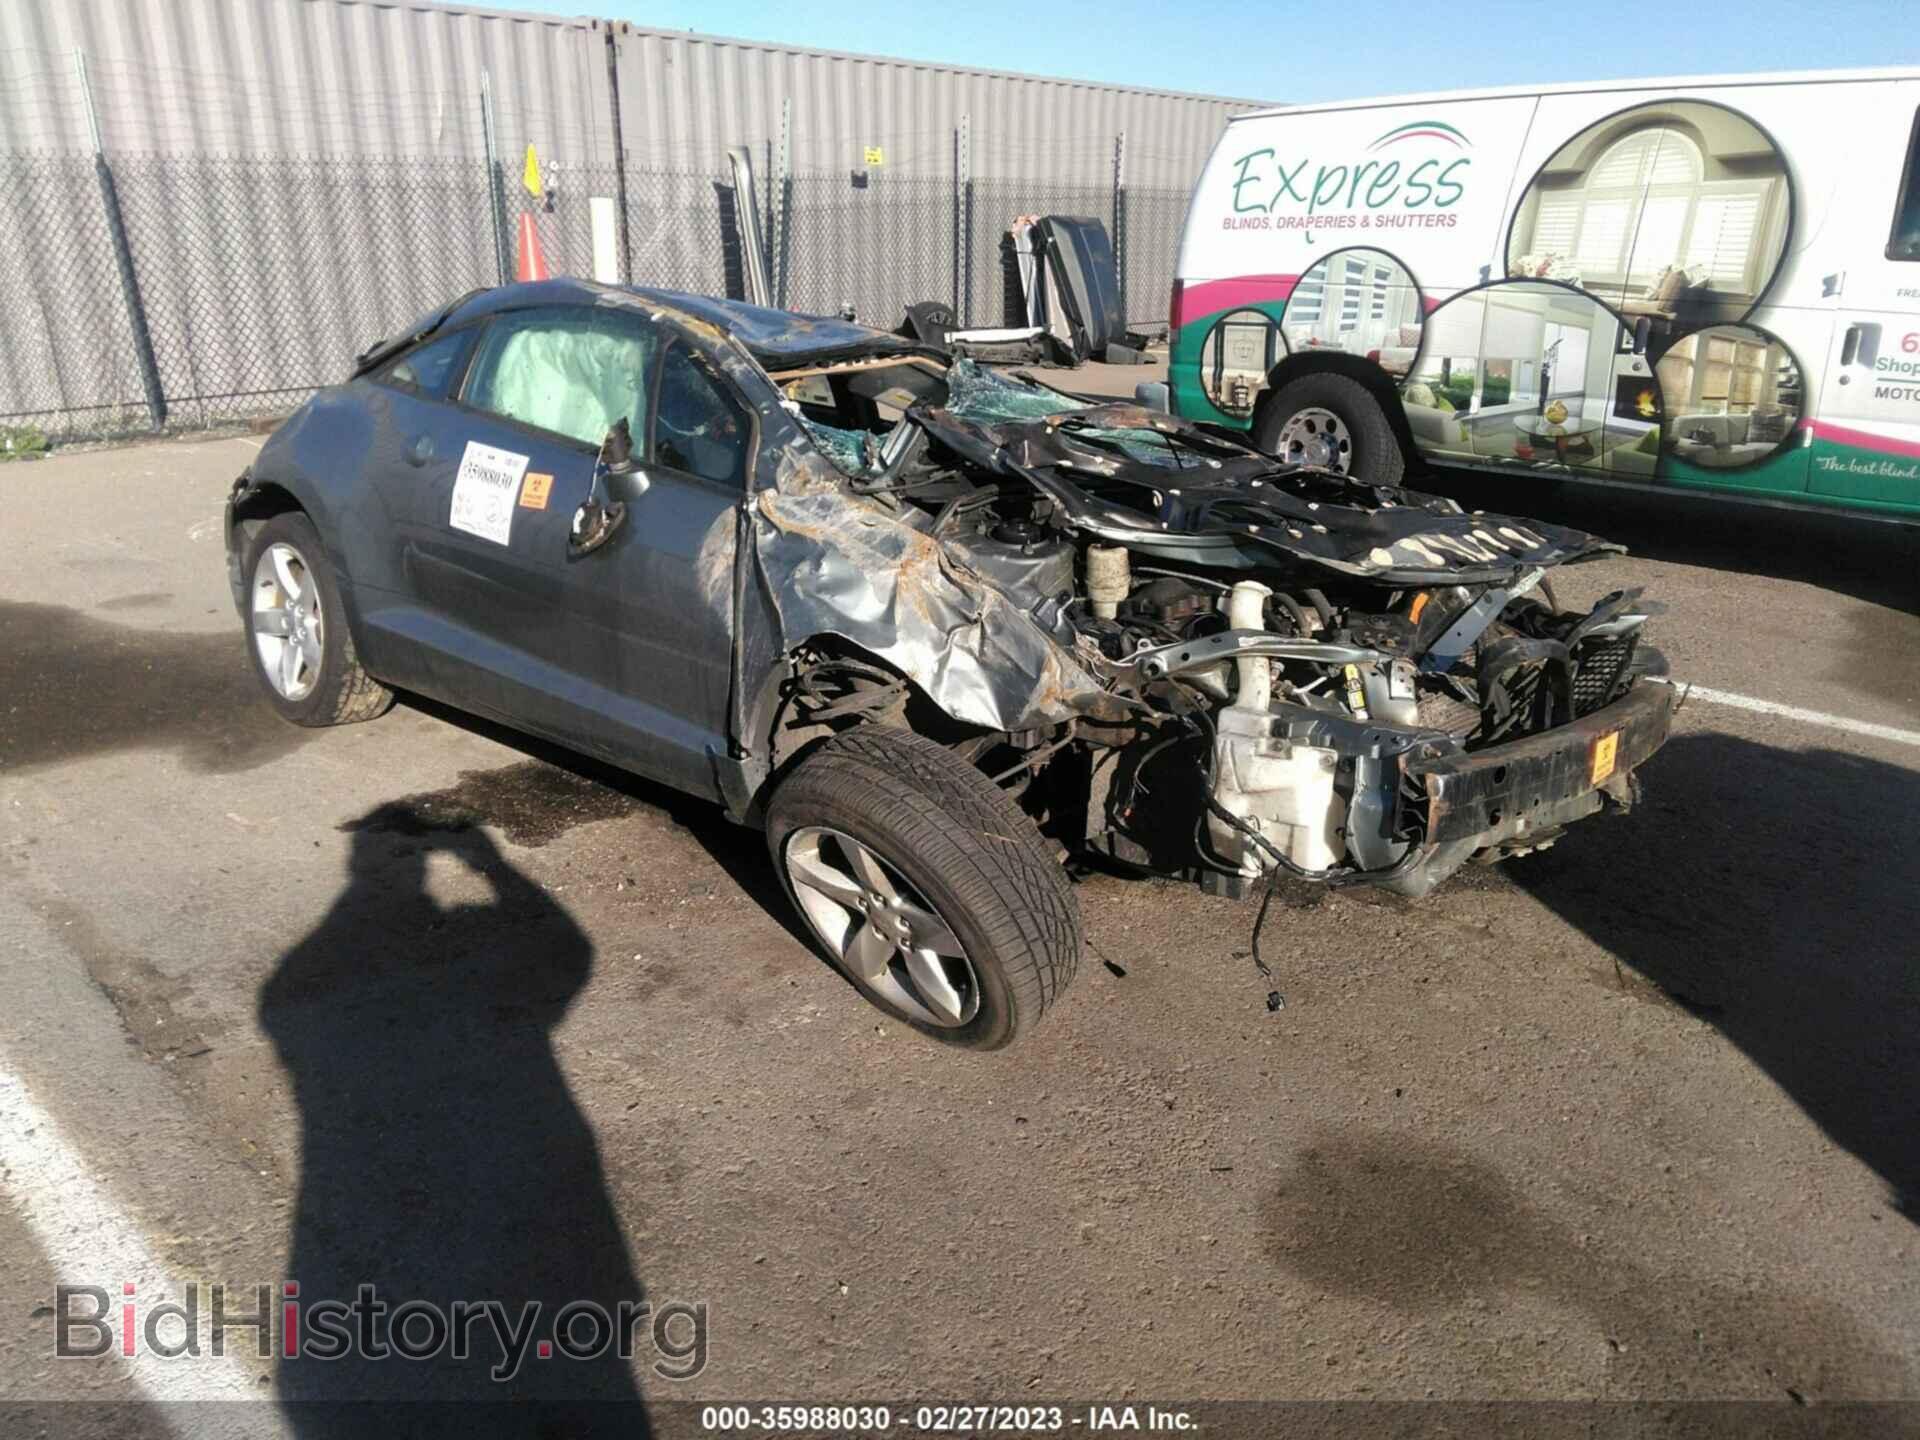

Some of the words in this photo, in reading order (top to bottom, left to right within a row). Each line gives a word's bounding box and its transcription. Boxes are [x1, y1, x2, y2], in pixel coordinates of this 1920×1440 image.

[1233, 148, 1471, 244] Express
[1222, 217, 1273, 230] BLINDS,
[1276, 215, 1357, 229] DRAPERIES
[1359, 214, 1370, 228] &
[1375, 213, 1458, 228] SHUTTERS
[1848, 458, 1877, 474] best
